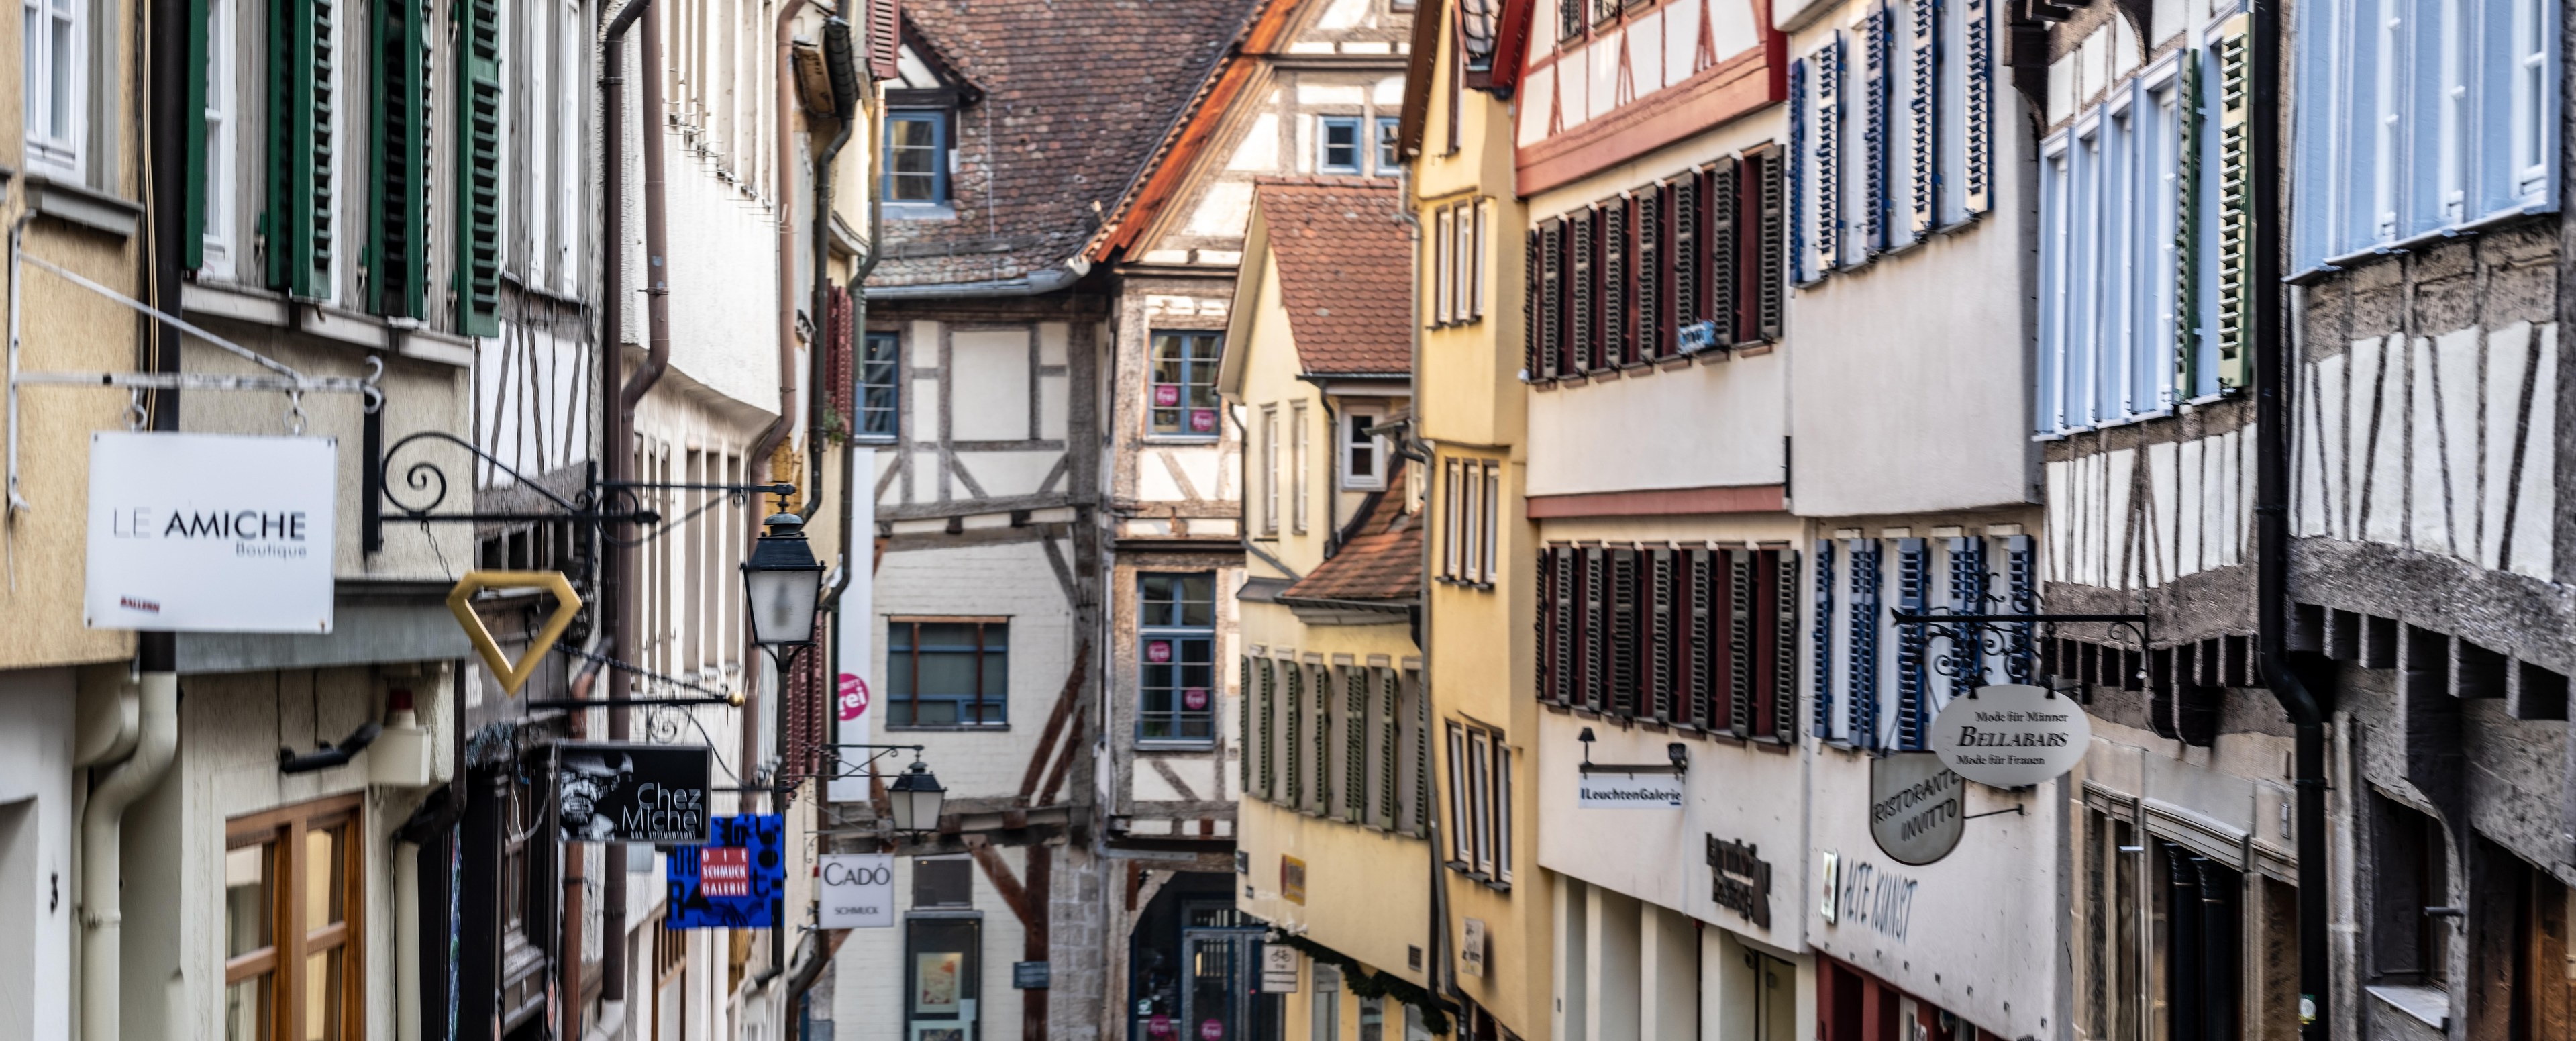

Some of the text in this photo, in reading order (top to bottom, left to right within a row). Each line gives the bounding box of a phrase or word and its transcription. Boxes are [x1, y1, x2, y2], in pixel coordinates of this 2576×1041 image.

[114, 507, 306, 541] LE AMICHE
[236, 541, 307, 560] Boutique
[838, 686, 866, 711] rei
[1975, 711, 2069, 722] Mode für Männer
[1956, 754, 2045, 765] Mode für Frauen
[637, 782, 701, 810] Chez
[622, 805, 702, 832] Michel
[1900, 797, 1957, 842] INVITTO
[703, 865, 746, 879] SCHMUCK
[824, 862, 890, 887] CADÓ
[50, 871, 58, 913] 3
[702, 882, 747, 897] GALERIE
[1843, 858, 1918, 945] ALTE KUNST
[835, 906, 879, 915] SCHMUCK
